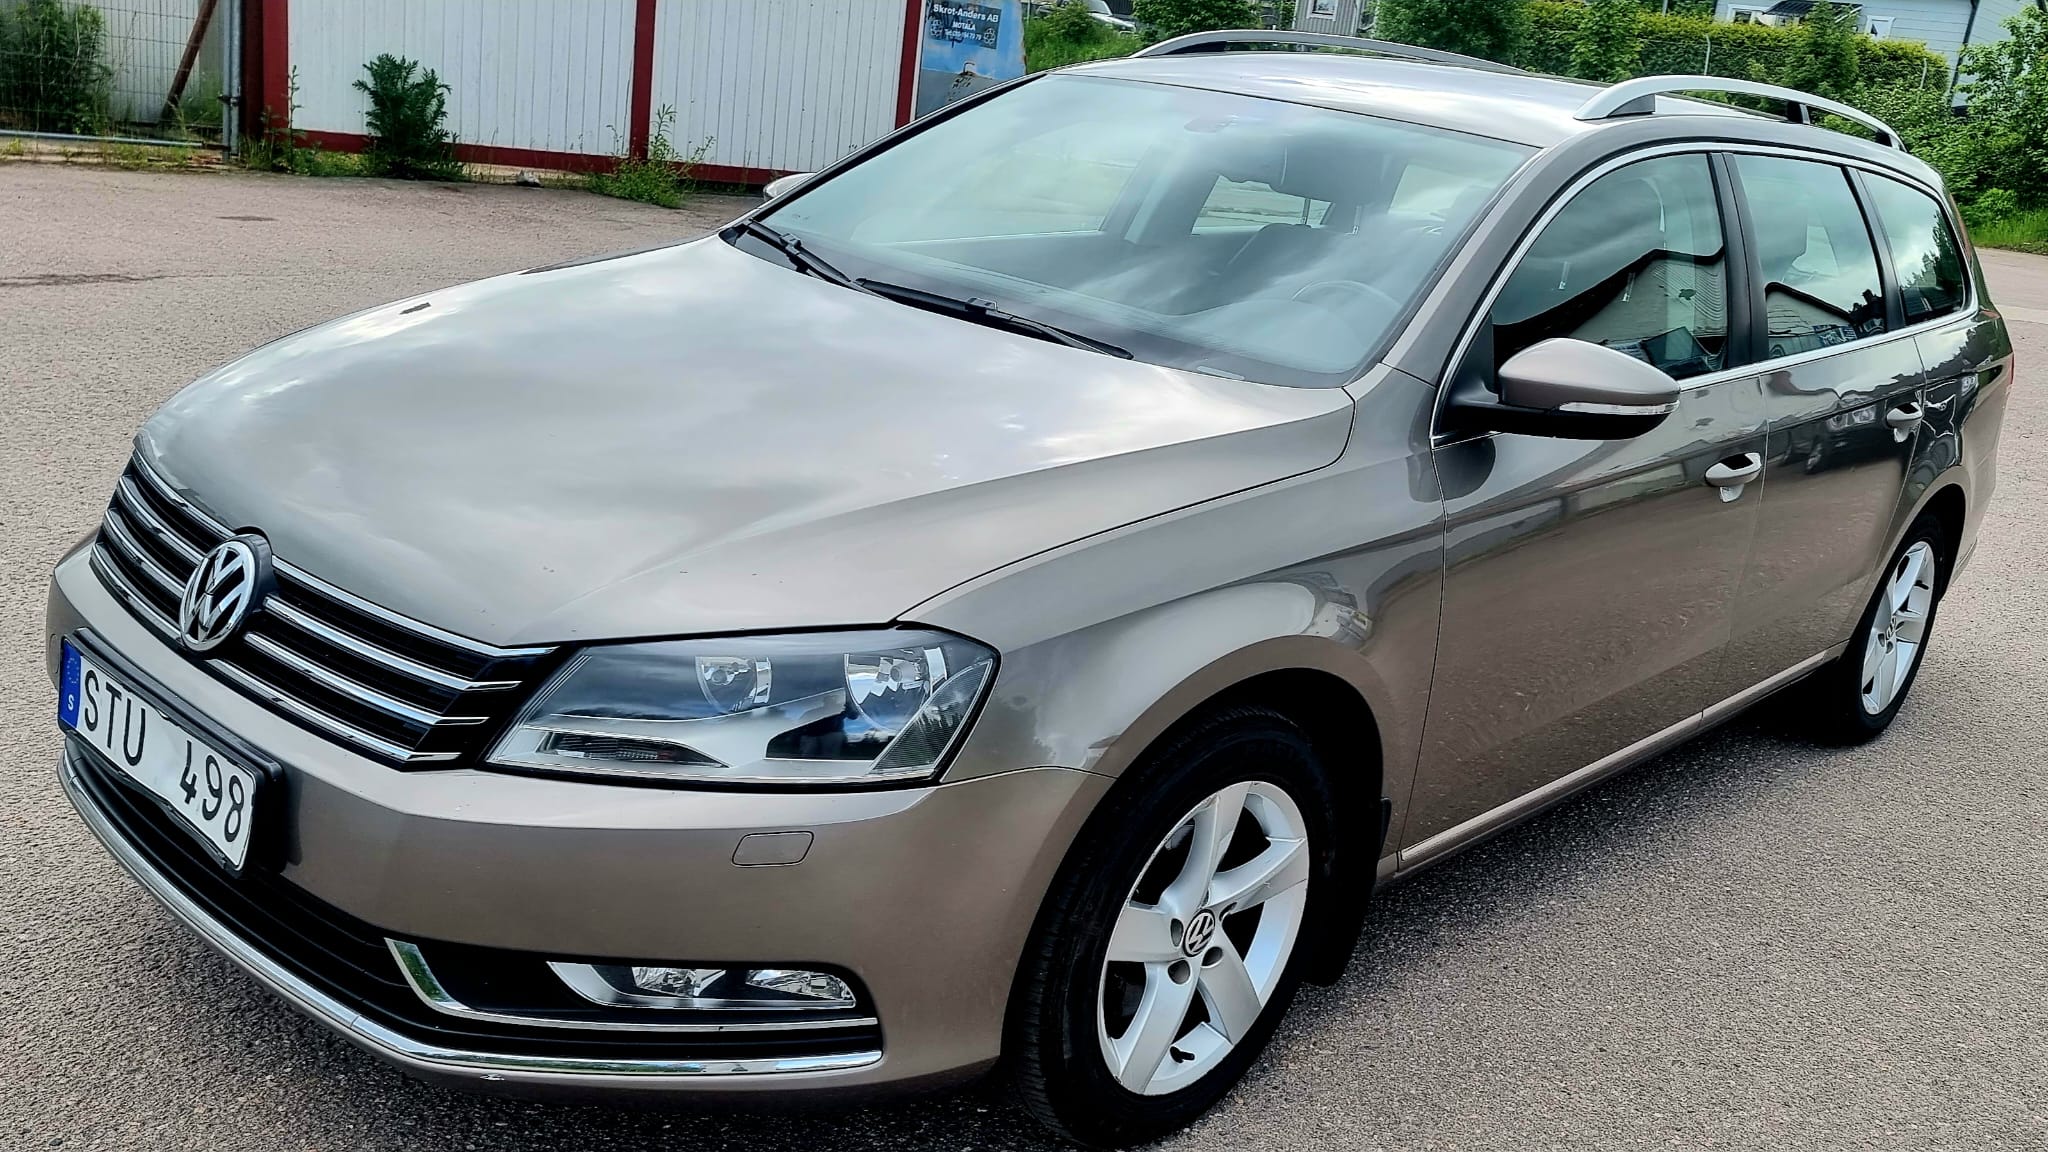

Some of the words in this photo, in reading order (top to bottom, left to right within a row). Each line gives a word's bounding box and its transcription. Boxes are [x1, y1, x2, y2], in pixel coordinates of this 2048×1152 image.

[933, 4, 986, 20] Skrot-Anders
[986, 14, 999, 23] AB
[952, 21, 976, 31] MOTALA
[67, 694, 75, 711] S
[85, 669, 146, 766] STU
[179, 740, 245, 842] 498
